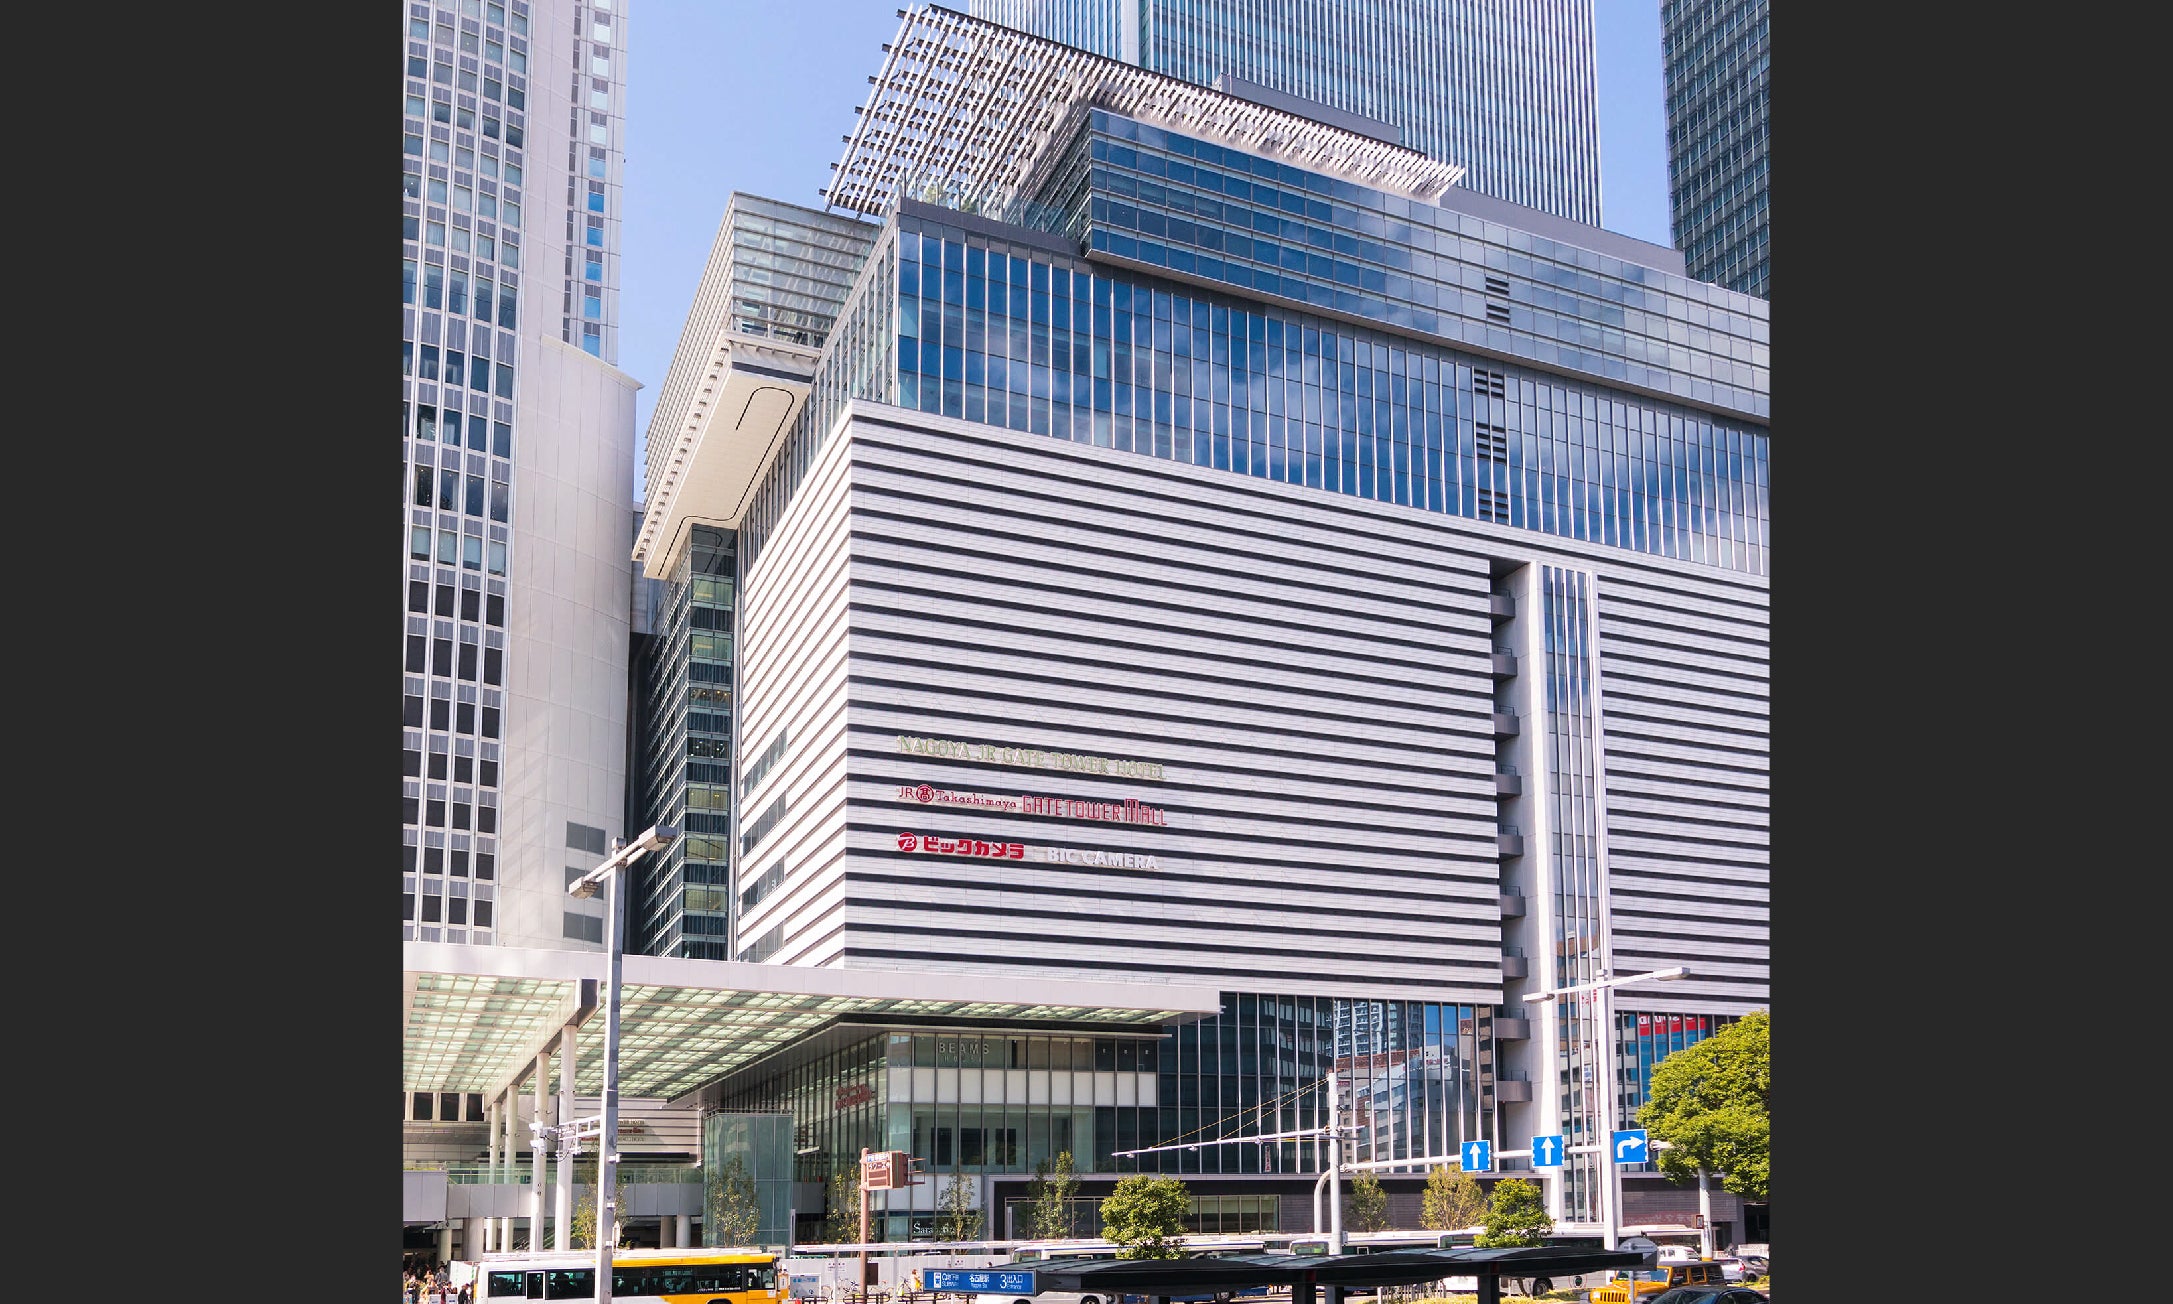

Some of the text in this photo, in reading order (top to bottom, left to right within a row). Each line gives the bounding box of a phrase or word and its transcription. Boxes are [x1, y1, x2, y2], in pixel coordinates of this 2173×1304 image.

[897, 735, 1167, 780] NAGOYA JR GATE TOWER HOTEL
[899, 786, 914, 799] JR
[936, 789, 1017, 811] Takashimaya
[923, 835, 1024, 859] ビックカメラ
[1047, 847, 1080, 863] BIC
[1082, 850, 1159, 870] CAMERA
[940, 1042, 989, 1055] BEAMS
[1000, 1274, 1007, 1289] 3
